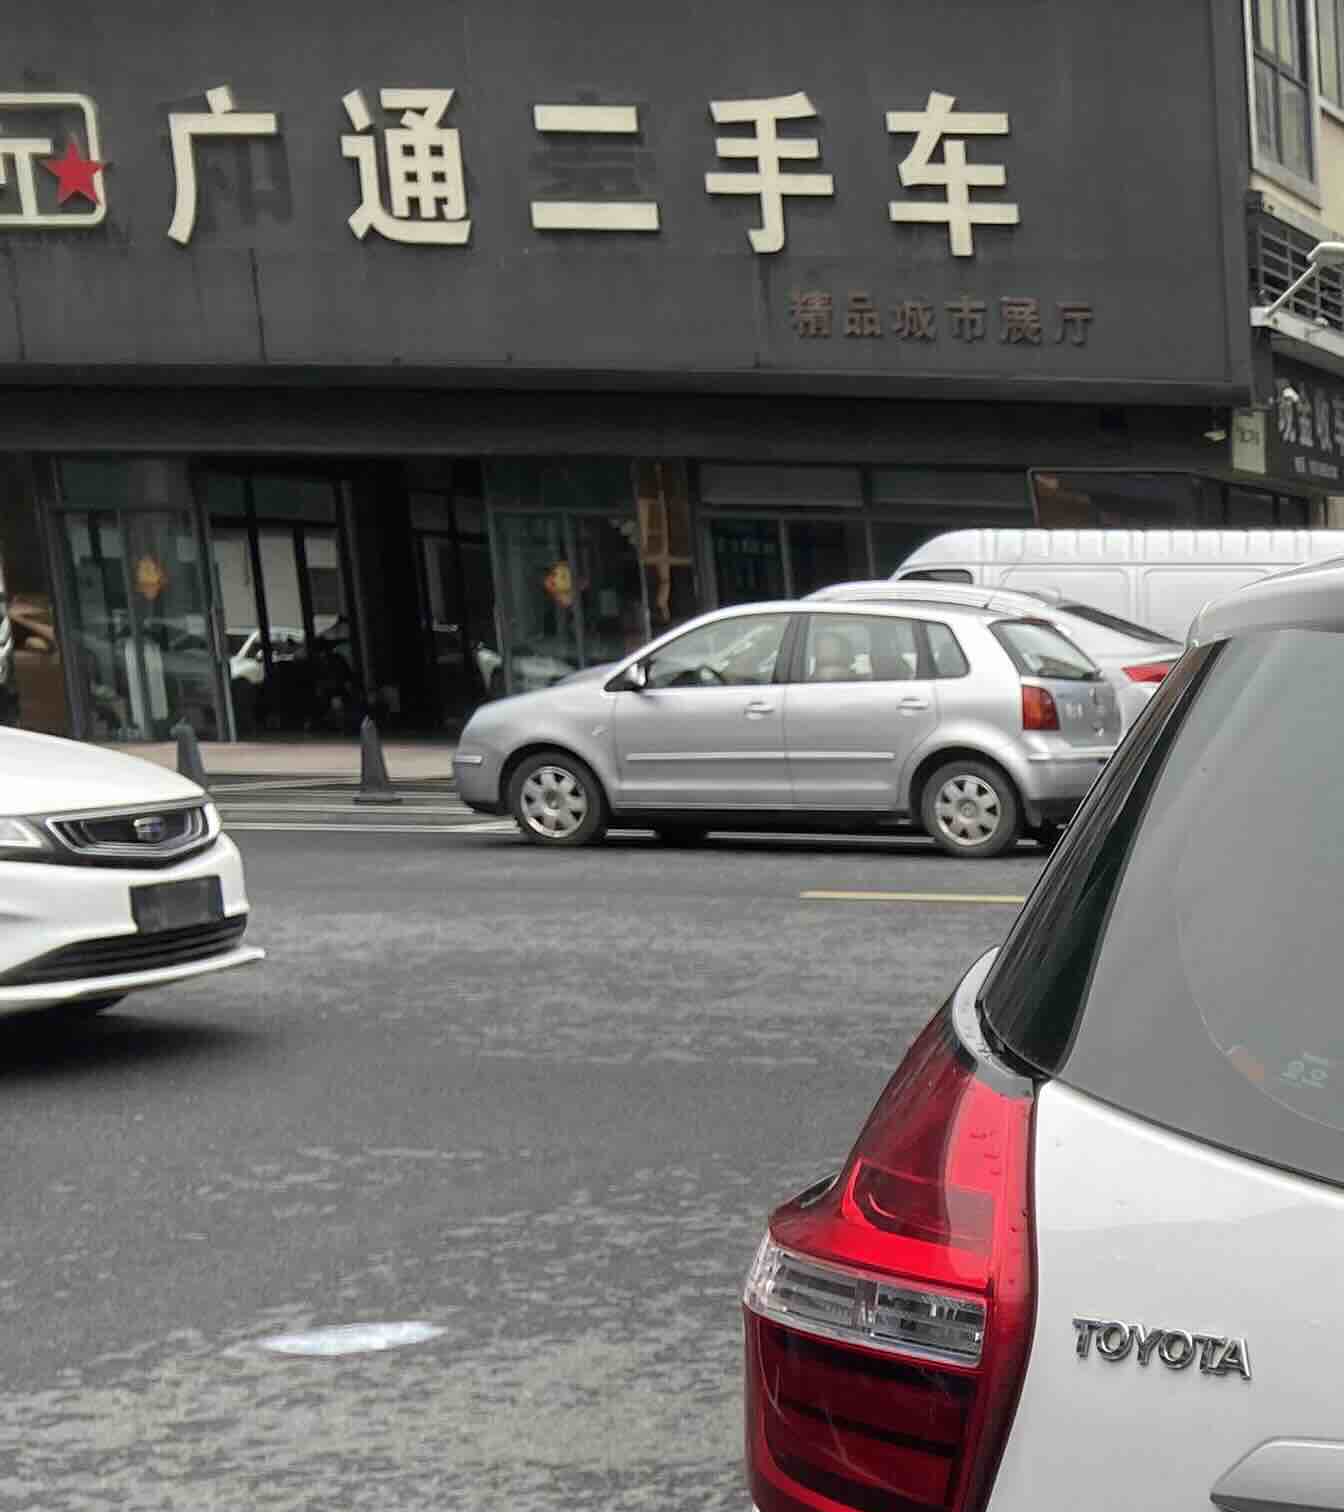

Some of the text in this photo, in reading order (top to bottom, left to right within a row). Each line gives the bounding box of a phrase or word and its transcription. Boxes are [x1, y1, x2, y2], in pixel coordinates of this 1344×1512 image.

[167, 86, 1020, 256] 广通二手车
[791, 290, 1093, 346] 精品城市展厅
[1072, 1315, 1252, 1380] TOYOTA
